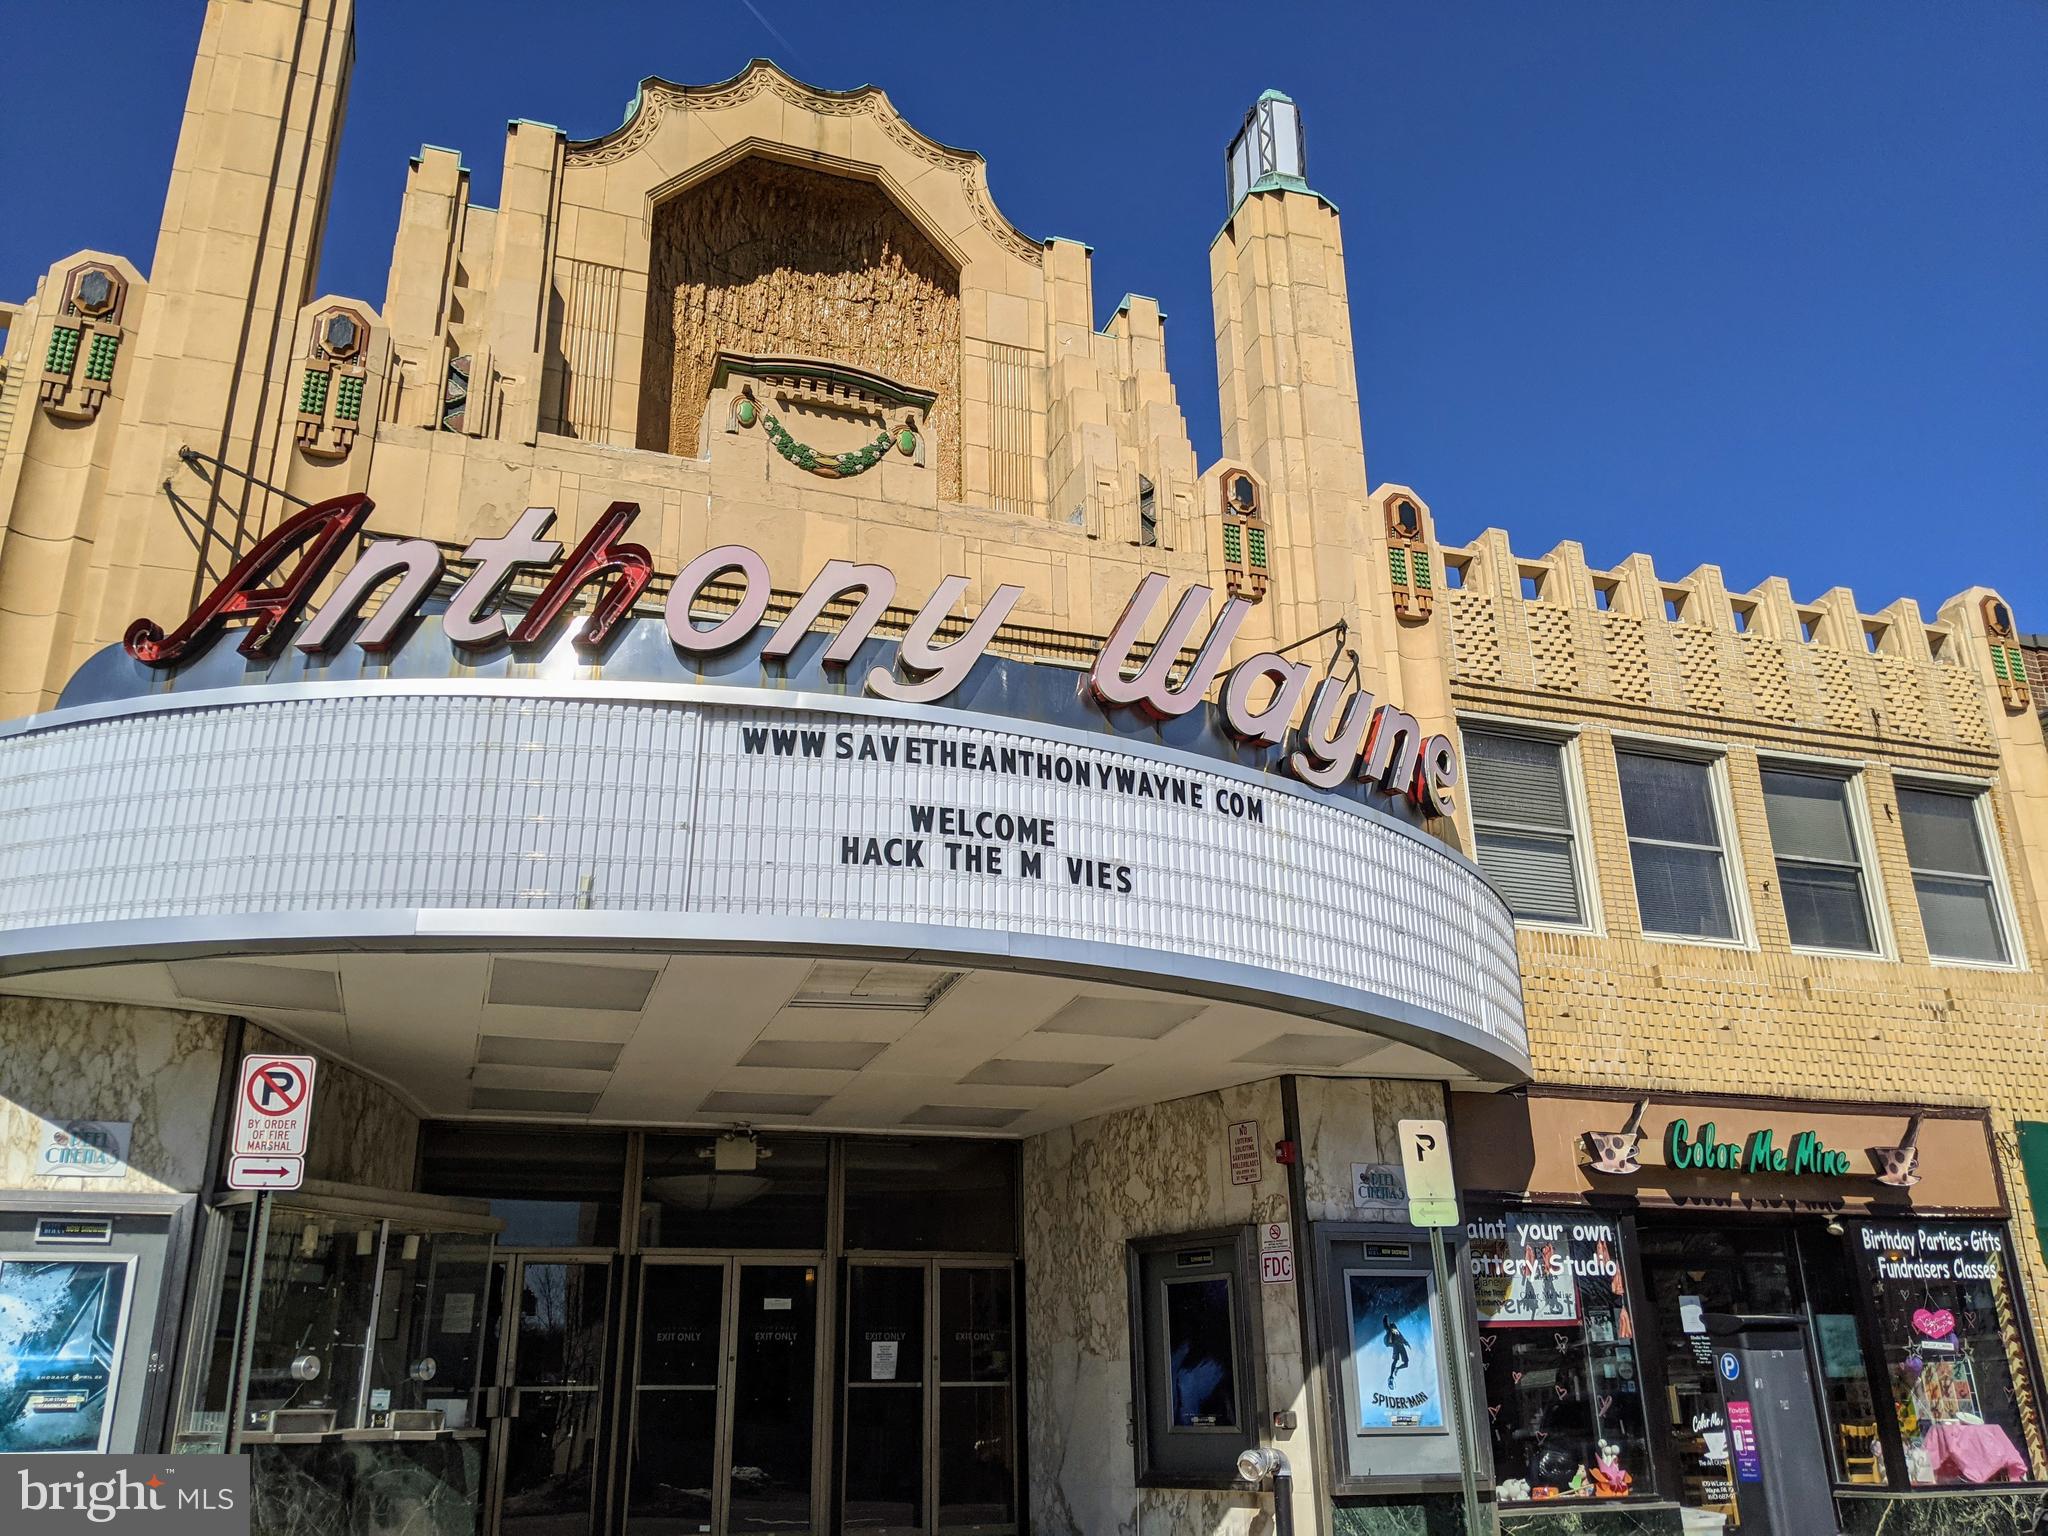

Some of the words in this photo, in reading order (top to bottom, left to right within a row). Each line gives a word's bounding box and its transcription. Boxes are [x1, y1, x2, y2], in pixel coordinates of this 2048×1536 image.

[123, 493, 1023, 703] Anthony
[1090, 571, 1459, 818] Wayne
[910, 805, 1055, 847] WELCOME
[841, 837, 924, 868] HACK
[945, 843, 1001, 874] THE
[247, 1120, 260, 1129] BY
[264, 1120, 297, 1129] ORDER
[252, 1130, 264, 1139] OF
[268, 1130, 290, 1139] FIRE
[246, 1141, 292, 1151] MARSHAL
[1665, 1118, 1742, 1170] Color
[1745, 1129, 1788, 1175] Me
[1789, 1130, 1851, 1176] Mine
[1466, 1216, 1507, 1240] aint
[1516, 1223, 1563, 1247] your
[1572, 1224, 1612, 1242] own
[1861, 1228, 1916, 1257] Birthday
[1918, 1229, 1962, 1251] Parties
[1970, 1230, 2002, 1252] Gifts
[1264, 1256, 1290, 1278] FDC
[1470, 1253, 1539, 1283] ottery
[1548, 1253, 1617, 1277] Studio
[1877, 1256, 1951, 1279] Fundraisers
[1953, 1257, 1998, 1279] Classes
[656, 1332, 675, 1342] EXIT
[678, 1332, 702, 1342] ONLY
[754, 1332, 773, 1341] EXIT
[774, 1332, 798, 1341] ONLY
[865, 1332, 881, 1340] EXIT
[883, 1332, 906, 1340] ONLY
[955, 1332, 972, 1341] EXIT
[973, 1332, 996, 1341] ONLY
[1371, 1391, 1429, 1409] SPIDER-MAN
[1692, 1412, 1710, 1433] Color
